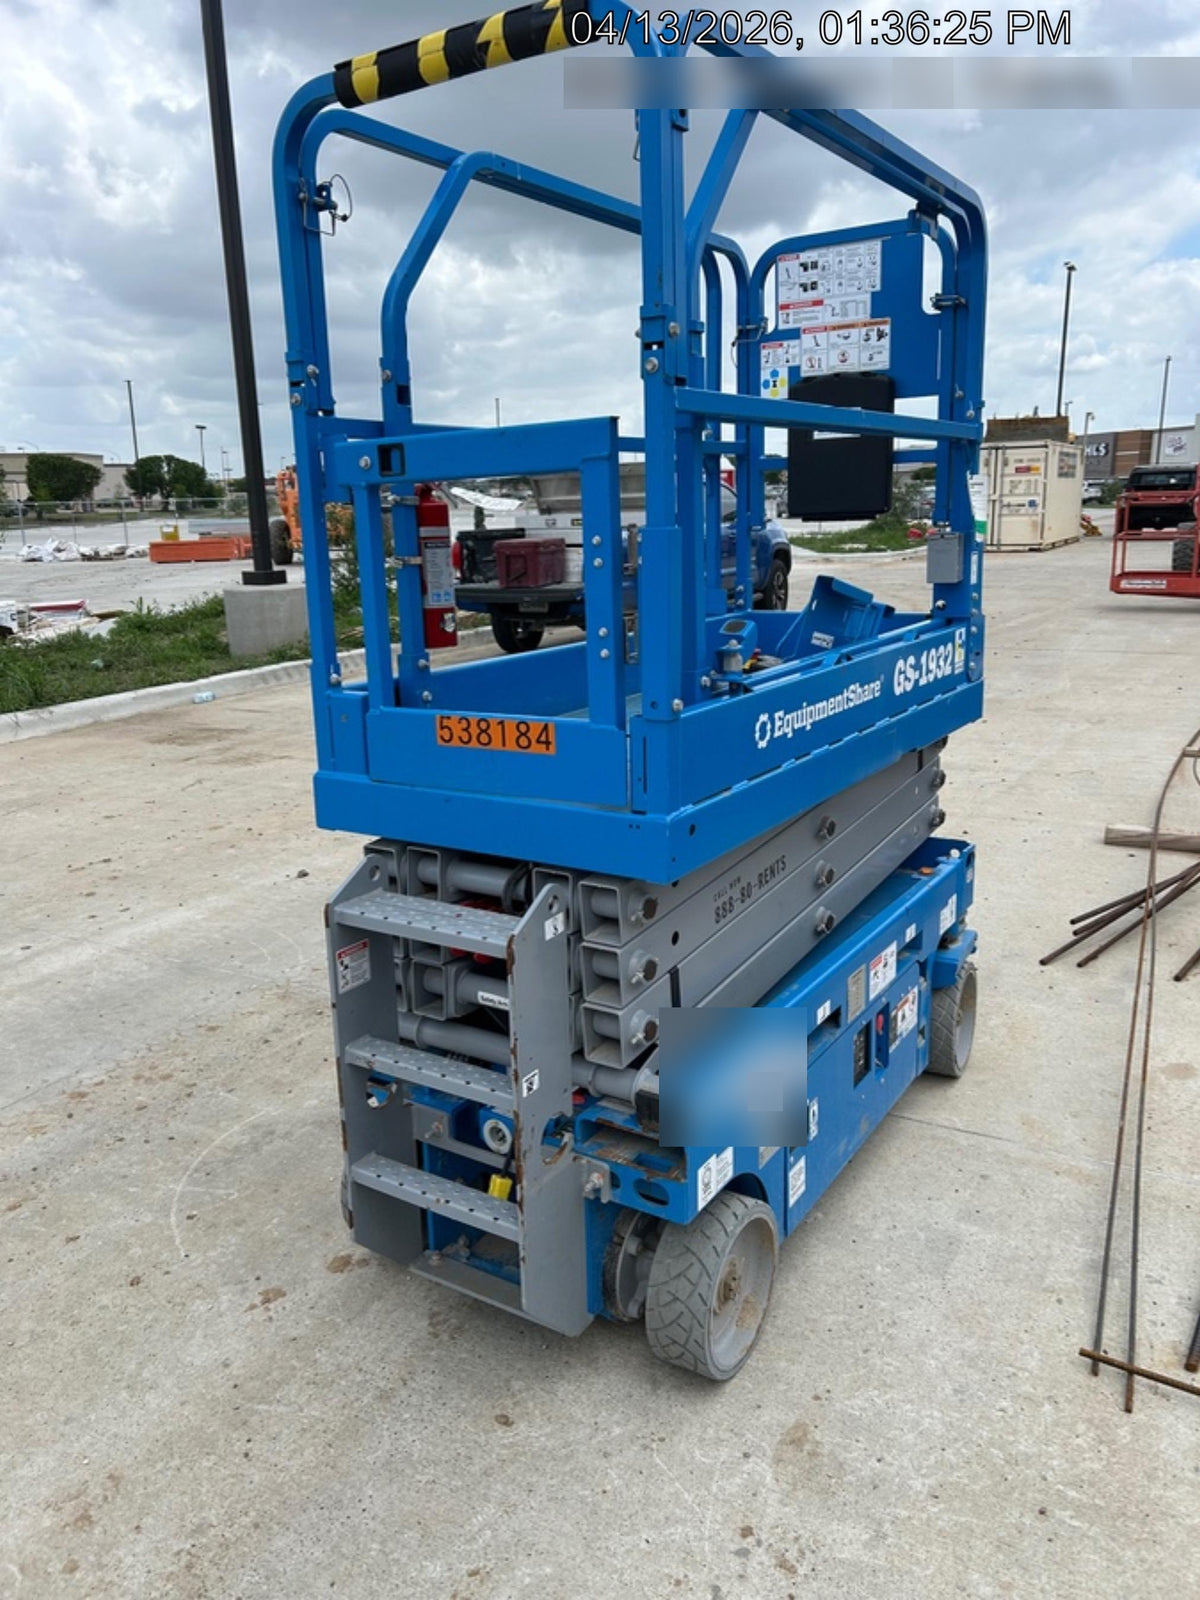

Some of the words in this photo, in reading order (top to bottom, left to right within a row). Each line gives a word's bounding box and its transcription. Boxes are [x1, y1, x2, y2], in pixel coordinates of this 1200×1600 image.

[893, 642, 953, 695] GS-1932
[439, 715, 552, 751] 538184
[772, 678, 881, 739] EquipmentShare
[714, 854, 787, 924] 888-80-RENTS
